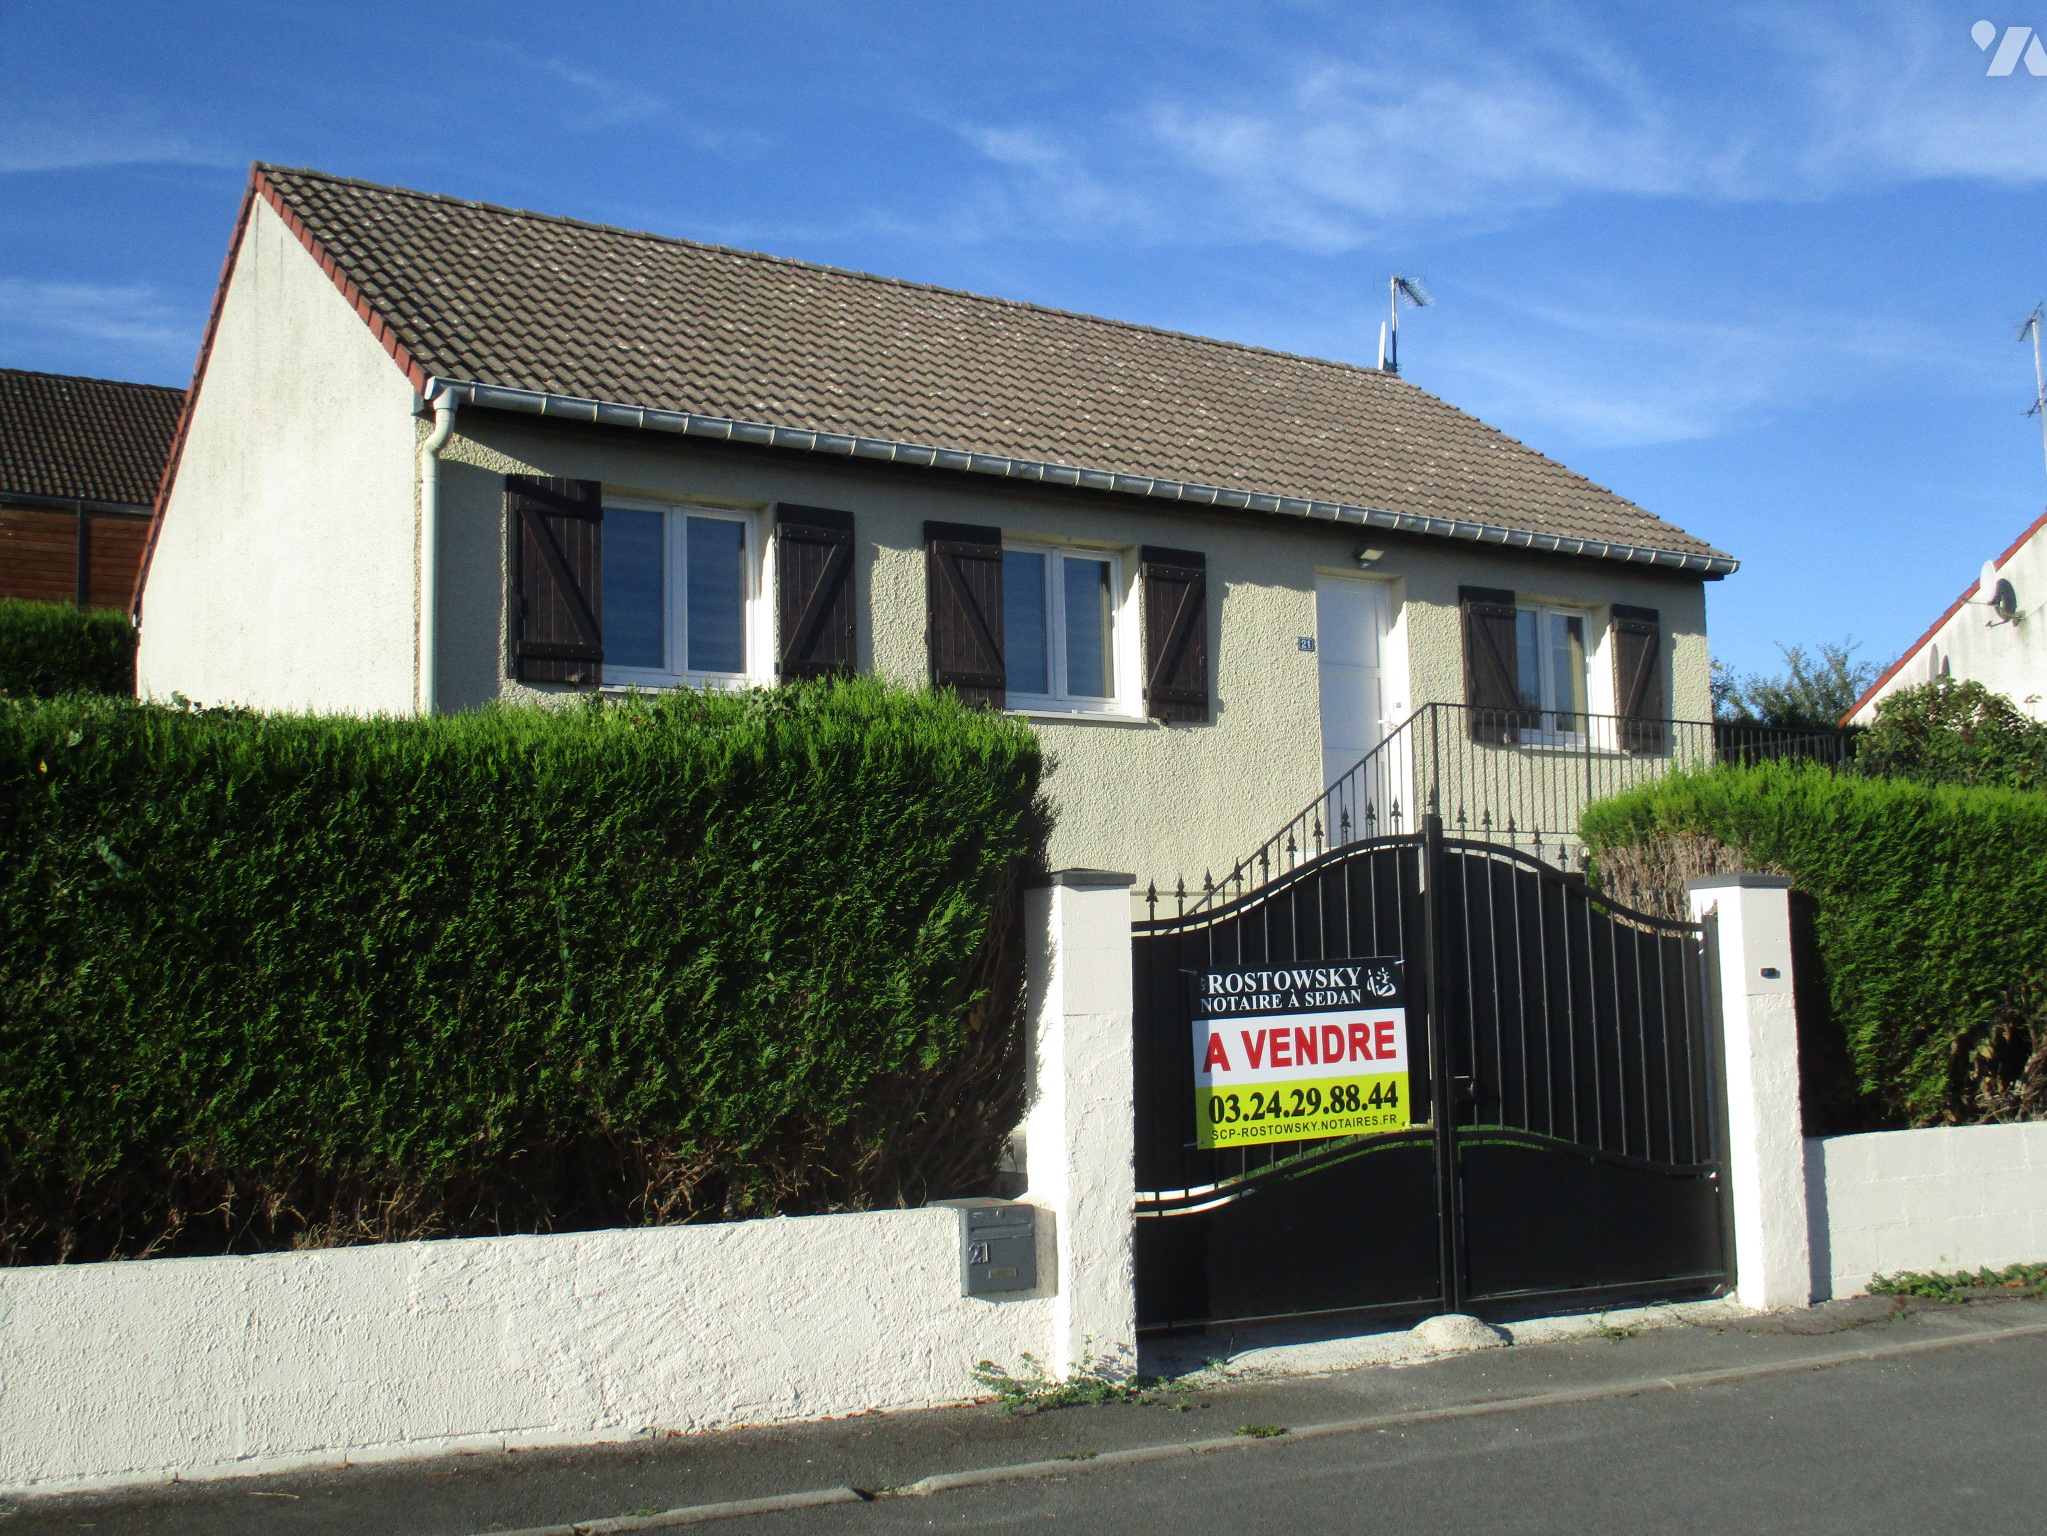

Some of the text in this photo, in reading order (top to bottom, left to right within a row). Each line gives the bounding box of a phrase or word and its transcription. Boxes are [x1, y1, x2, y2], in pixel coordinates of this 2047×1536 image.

[1301, 640, 1311, 649] 21
[1207, 967, 1361, 995] ROSTOWSKY
[1201, 989, 1361, 1013] NOTAIRE À SEDAN
[1203, 1020, 1397, 1073] A VENDRE
[1208, 1080, 1399, 1125] 03.24.29.88.44
[1211, 1114, 1397, 1141] SCP-ROSTOWSKY.NOTAIRES.FR
[968, 1241, 989, 1265] 21
